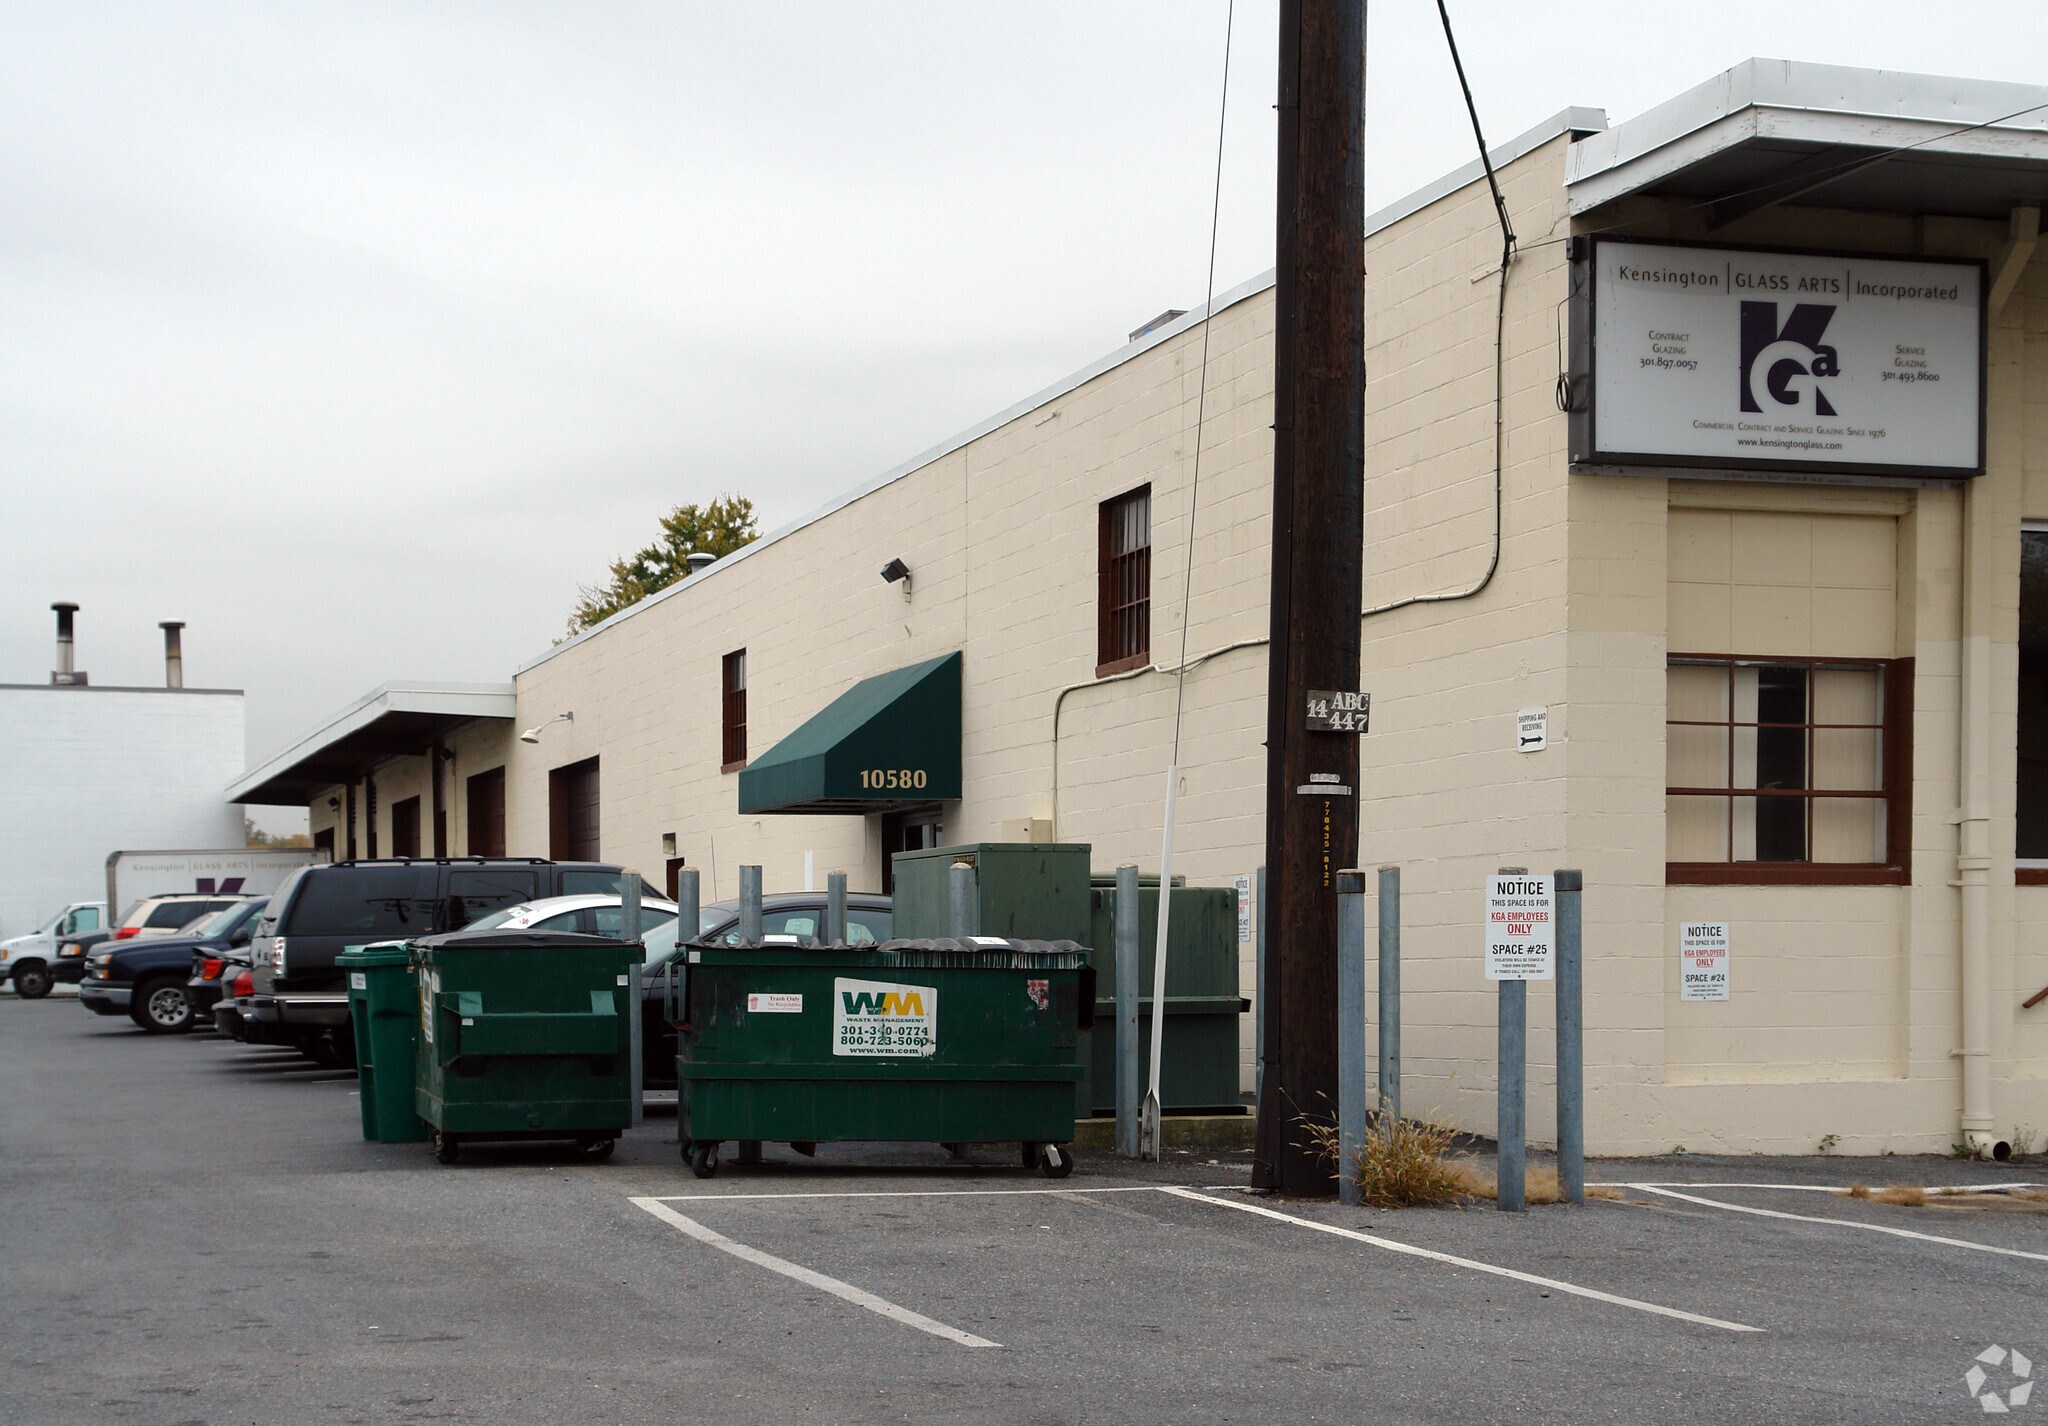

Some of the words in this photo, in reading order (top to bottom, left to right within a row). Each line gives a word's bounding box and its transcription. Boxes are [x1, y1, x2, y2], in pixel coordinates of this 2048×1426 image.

[1619, 265, 1718, 288] Kensington
[1735, 272, 1789, 290] GLASS
[1798, 277, 1840, 294] ARTS
[1856, 280, 1958, 300] Incorporated
[1640, 356, 1698, 371] 301.897.0057
[1882, 371, 1940, 382] 301.493.8600
[1737, 438, 1843, 451] www.kensingtonglass.com
[1330, 691, 1369, 711] ABC
[1307, 699, 1328, 718] 14
[1328, 711, 1368, 731] 447
[860, 769, 927, 789] 10580
[133, 863, 185, 872] Kensington
[193, 862, 222, 870] GLASS
[1497, 881, 1544, 895] NOTICE
[1491, 899, 1506, 907] THIS
[1507, 899, 1527, 907] SPACE
[1528, 899, 1535, 907] IS
[1536, 899, 1549, 907] FOR
[1491, 911, 1506, 921] KGA
[1507, 911, 1549, 921] EMPLOYEES
[1507, 923, 1533, 934] ONLY
[1688, 926, 1722, 937] NOTICE
[1492, 944, 1524, 955] SPACE
[1526, 944, 1547, 955] #25
[1695, 949, 1726, 957] EMPLOYEES
[1696, 958, 1714, 967] ONLY
[1685, 974, 1709, 982] SPACE
[1710, 973, 1725, 982] #24
[842, 992, 924, 1016] WM
